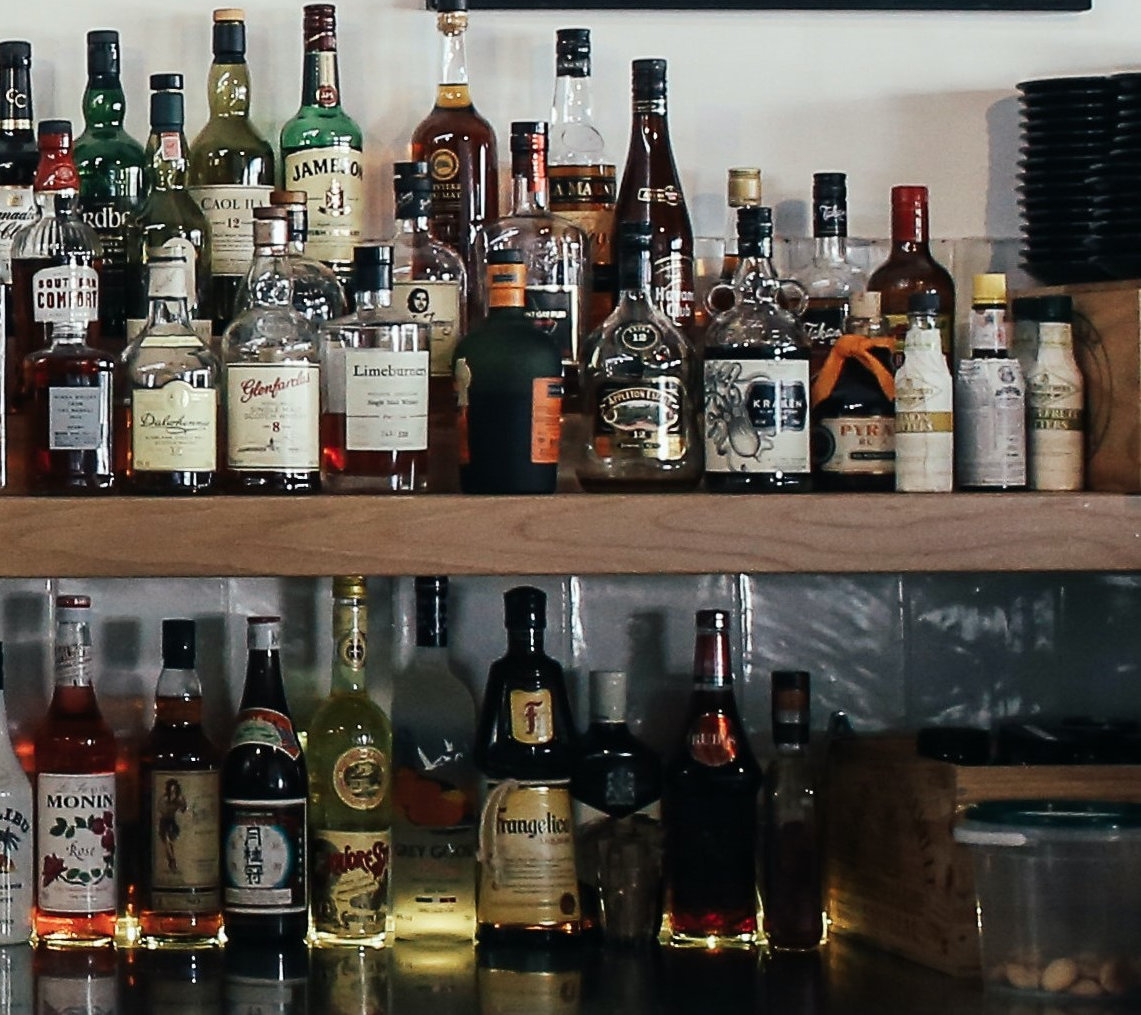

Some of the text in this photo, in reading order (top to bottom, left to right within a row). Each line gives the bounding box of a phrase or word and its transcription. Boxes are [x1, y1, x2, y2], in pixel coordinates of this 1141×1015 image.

[201, 197, 240, 210] CAOL
[227, 217, 240, 228] 12
[272, 422, 280, 432] 8
[46, 794, 113, 809] MONIN
